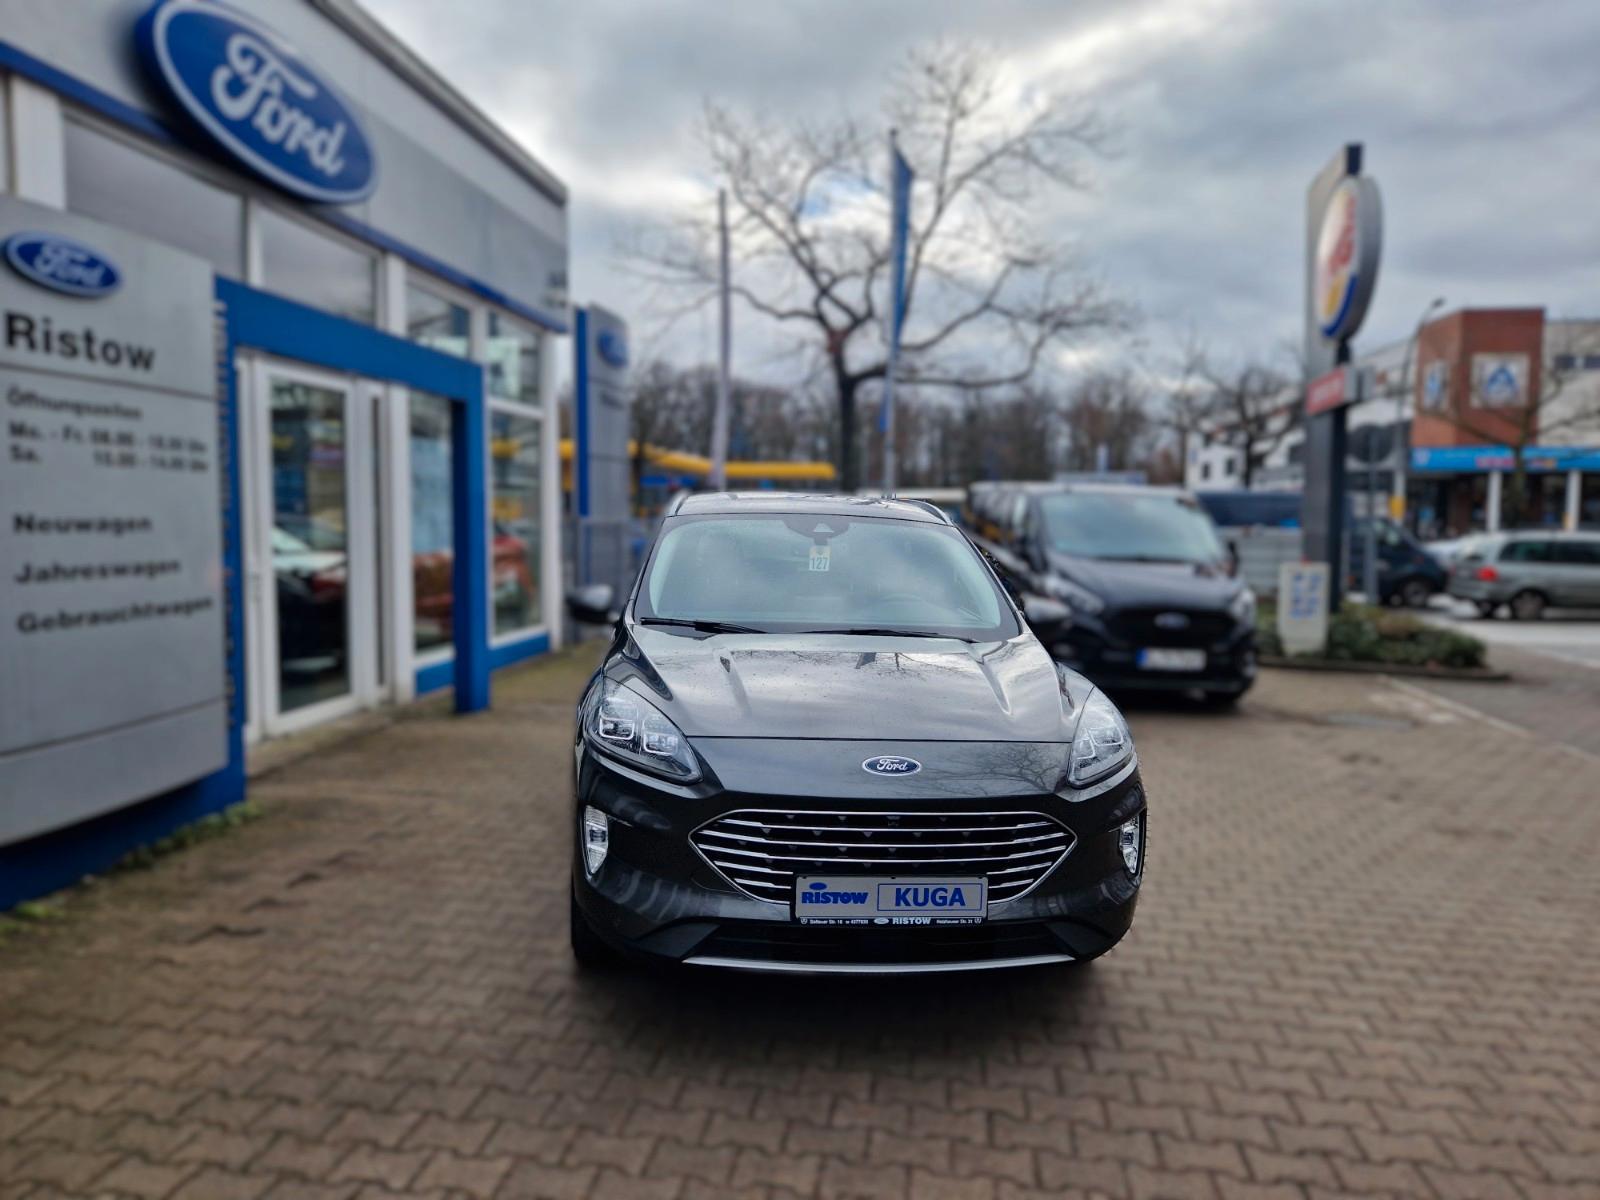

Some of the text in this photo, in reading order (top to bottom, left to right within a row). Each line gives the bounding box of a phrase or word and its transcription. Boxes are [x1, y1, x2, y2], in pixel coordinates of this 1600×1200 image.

[212, 30, 348, 177] Ford
[33, 242, 107, 287] Ford
[5, 311, 156, 372] Ristow
[14, 514, 151, 537] Neuwagen
[15, 560, 180, 585] Jahreswagen
[811, 556, 829, 570] 127
[17, 597, 213, 634] Gebrauchtwagen
[876, 758, 908, 771] Ford
[801, 891, 869, 905] RISTOW
[894, 887, 966, 908] KUGA
[892, 917, 932, 925] RISTOW
